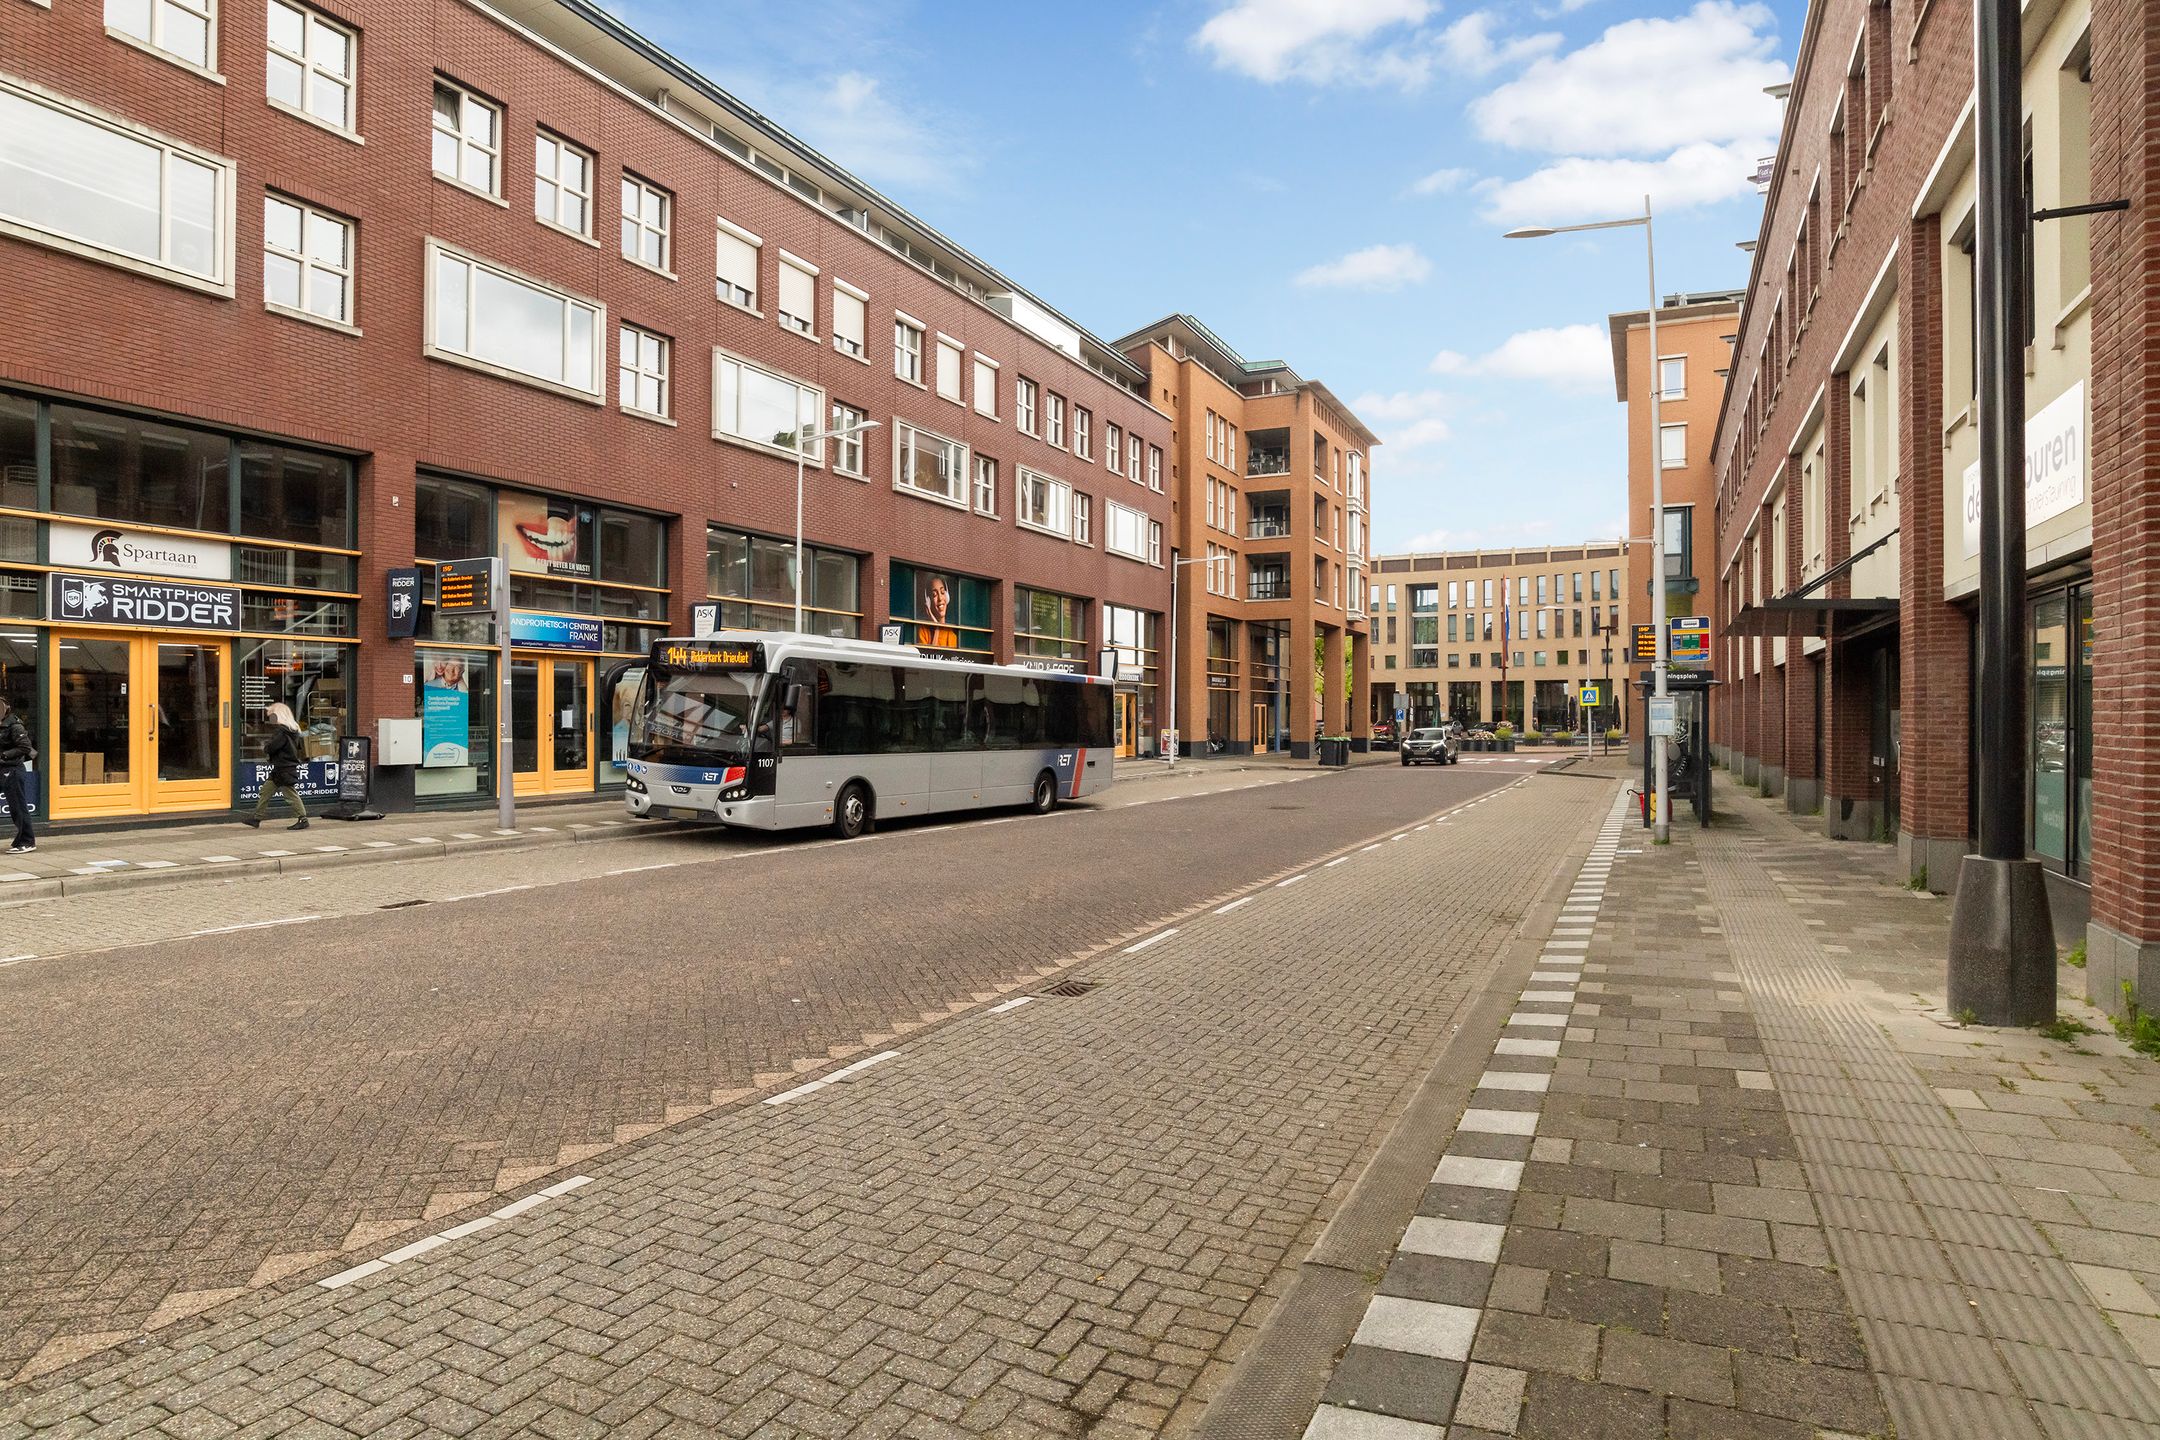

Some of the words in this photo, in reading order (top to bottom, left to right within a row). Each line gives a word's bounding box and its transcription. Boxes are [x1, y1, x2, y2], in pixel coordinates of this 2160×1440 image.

[123, 543, 197, 564] Spartaan
[112, 583, 233, 605] SMARTPHONE
[112, 597, 233, 625] RIDDER
[696, 608, 714, 618] ASK
[511, 618, 568, 629] ANDPROTHETISCH
[569, 622, 598, 632] CENTRUM
[569, 631, 598, 642] FRANKE
[884, 628, 899, 636] ASK
[667, 647, 687, 665] 144
[690, 650, 722, 663] Ridderkerk
[722, 650, 749, 664] Drievliet
[758, 758, 774, 768] 1107
[1057, 754, 1072, 766] RET
[702, 772, 718, 781] RET
